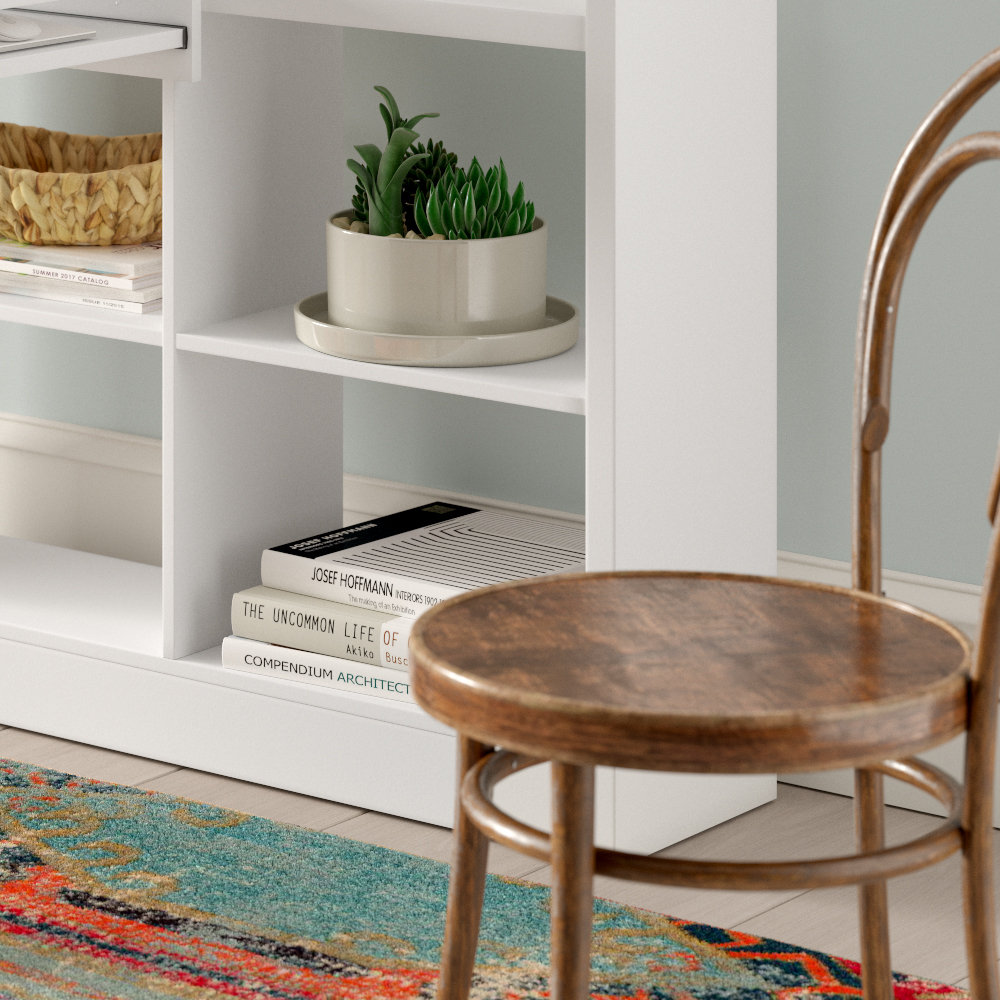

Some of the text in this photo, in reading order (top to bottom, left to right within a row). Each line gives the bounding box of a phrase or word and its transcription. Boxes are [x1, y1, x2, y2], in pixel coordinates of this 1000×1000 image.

[32, 268, 59, 278] SUMMER
[78, 275, 110, 286] CATALOG
[311, 566, 338, 585] JOSEF
[340, 573, 394, 597] HOFFMANN
[395, 589, 423, 604] INTERIORS
[242, 601, 399, 647] THE UNCOMMON LIFE OF
[346, 644, 374, 660] Akiko
[244, 654, 333, 680] COMPENDIUM
